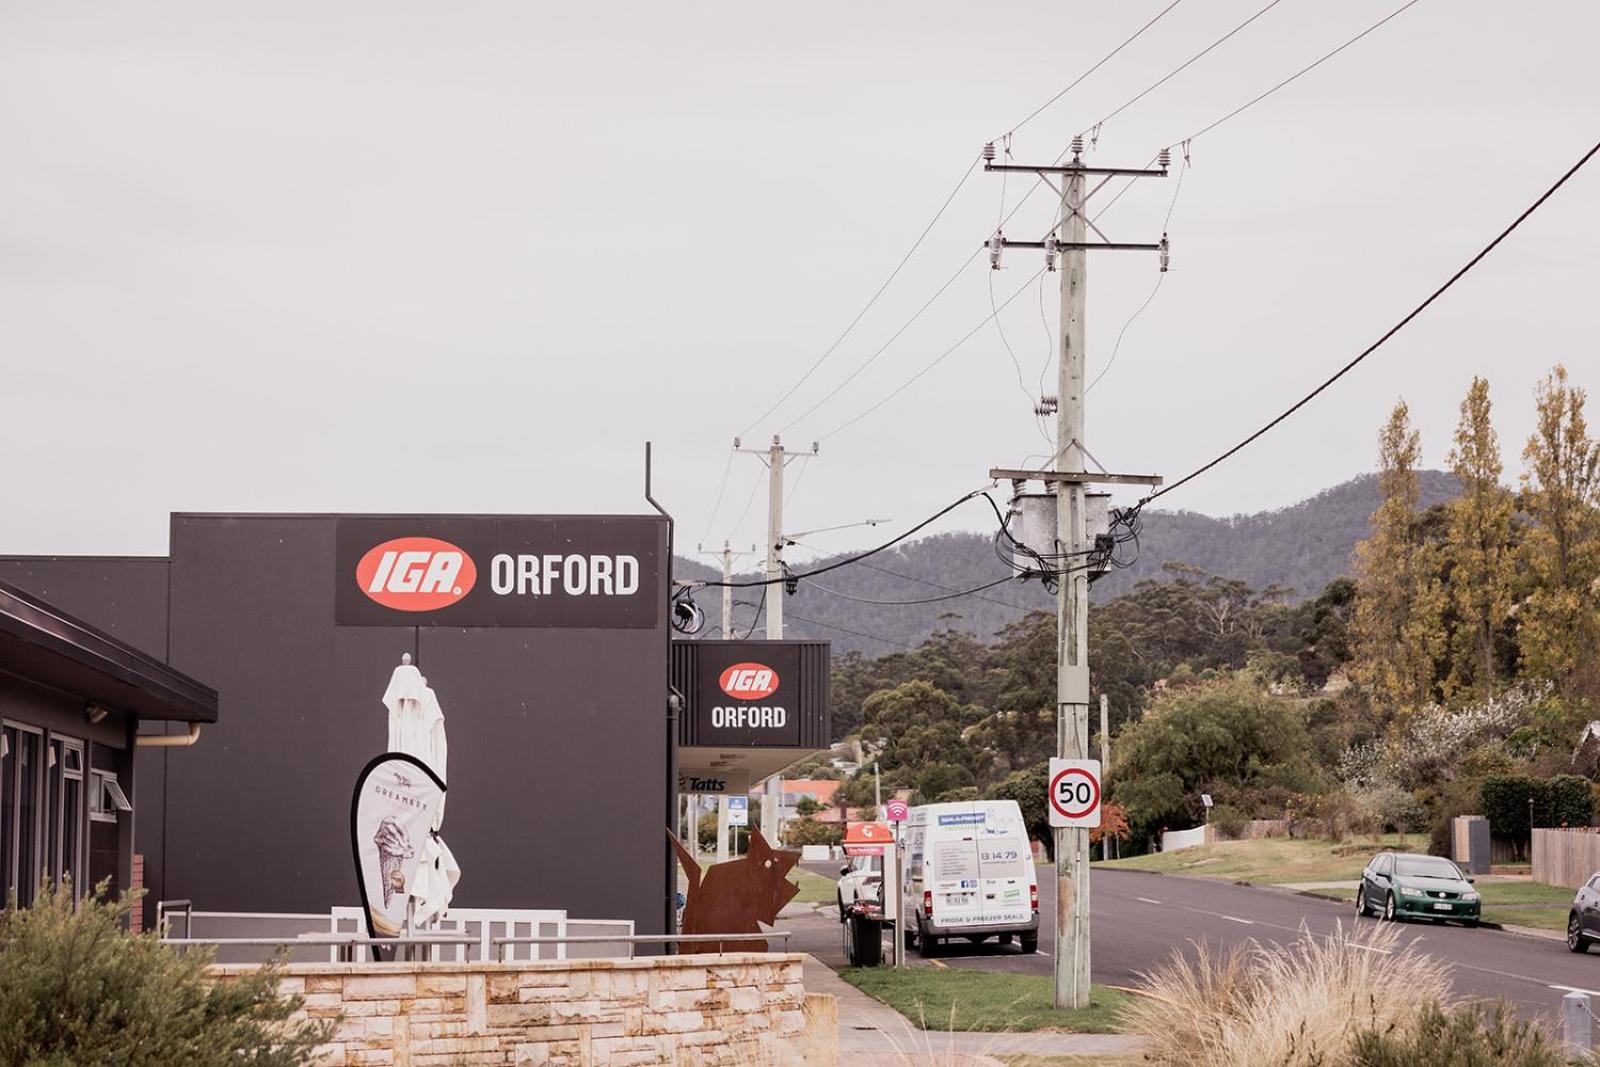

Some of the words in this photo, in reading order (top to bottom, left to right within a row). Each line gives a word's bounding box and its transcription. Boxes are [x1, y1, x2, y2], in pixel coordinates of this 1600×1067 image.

[368, 551, 463, 594] IGA
[491, 554, 639, 596] ORFORD
[725, 669, 773, 692] IGA
[711, 706, 786, 728] ORFORD
[689, 777, 726, 791] Tatts
[1060, 782, 1091, 804] 50
[993, 852, 1002, 860] 14
[1004, 850, 1018, 860] 79
[973, 914, 1002, 922] FREEZER
